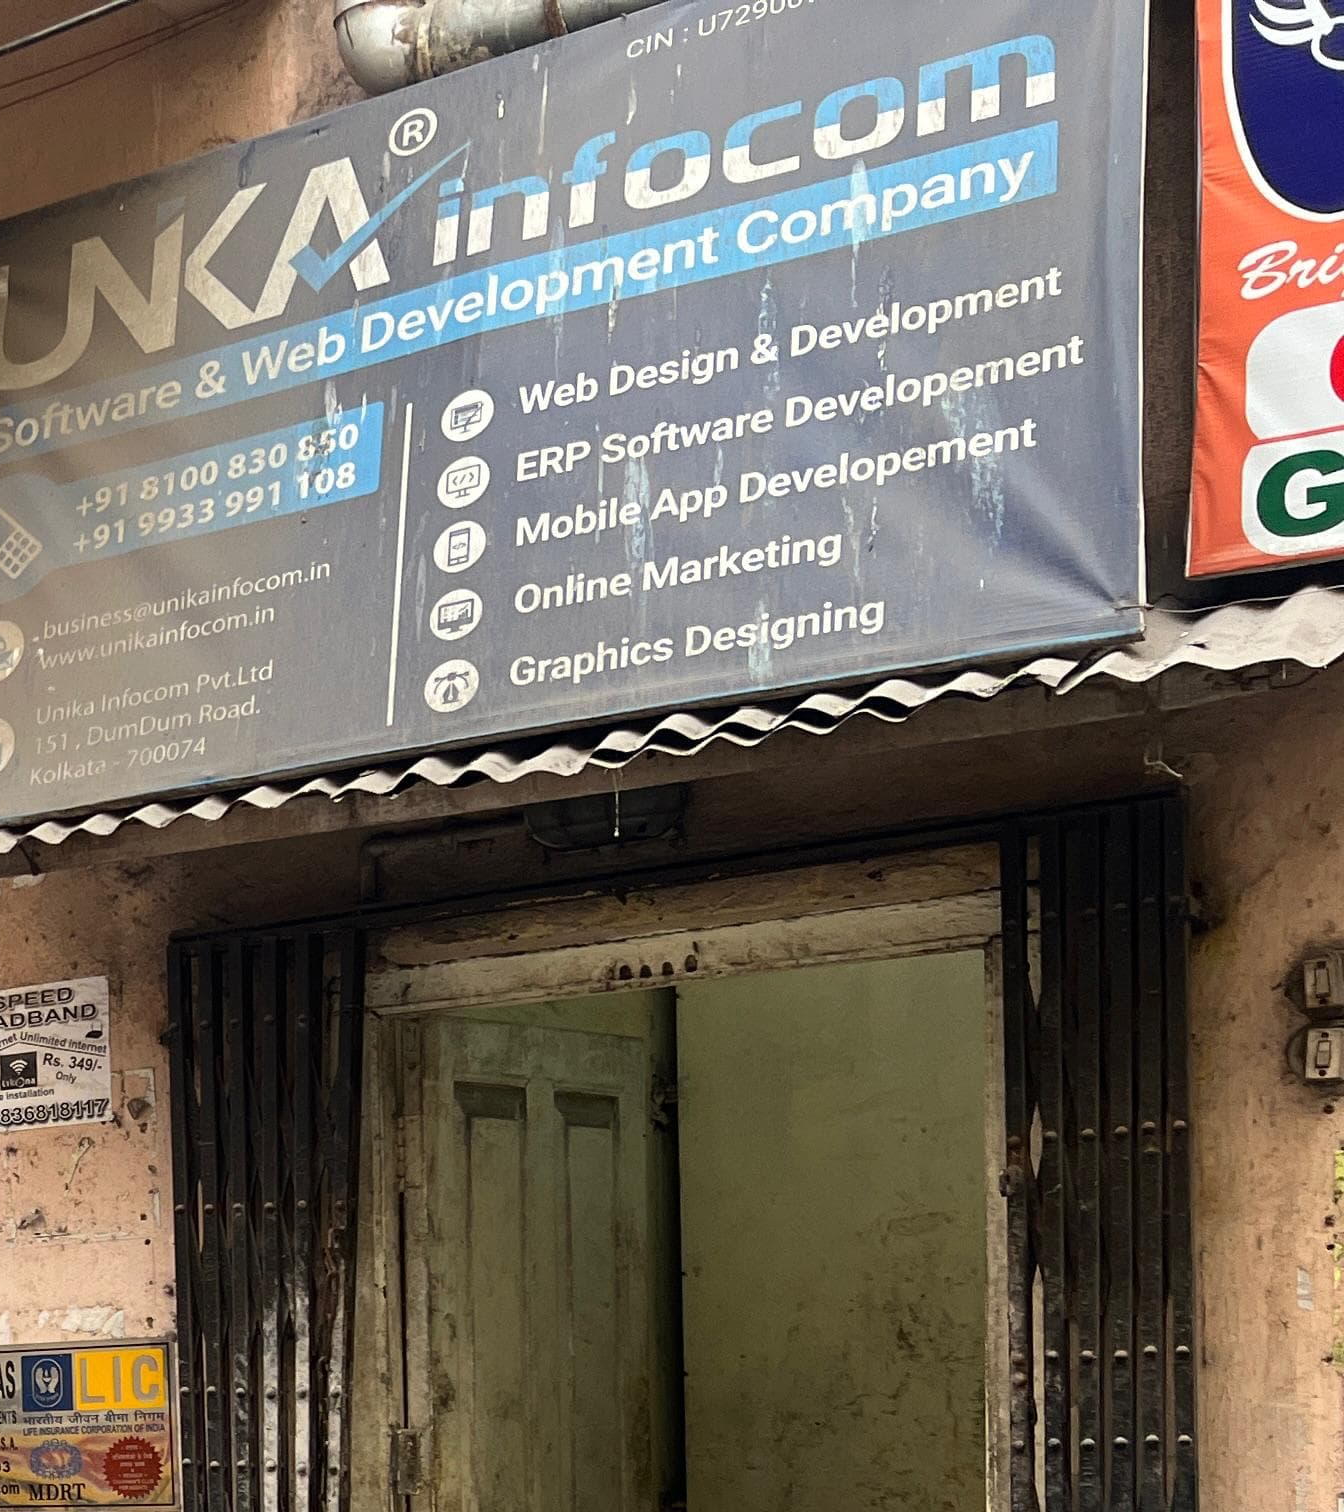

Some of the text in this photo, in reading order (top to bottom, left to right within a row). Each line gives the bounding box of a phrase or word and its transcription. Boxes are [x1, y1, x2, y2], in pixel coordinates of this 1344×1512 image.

[432, 34, 1056, 266] infocom
[196, 358, 227, 401] &
[242, 327, 345, 386] Web
[360, 225, 719, 353] Development
[736, 149, 1035, 254] Company
[1237, 240, 1344, 300] Bri
[519, 266, 1062, 414] Web Design & Development
[516, 334, 1085, 482] ERP Software Developement
[73, 463, 356, 555] +91 9933 991 108
[76, 484, 128, 518] +91
[141, 461, 218, 500] 8100
[227, 444, 288, 479] 830
[516, 419, 1037, 548] Mobile App Developement
[43, 562, 331, 640] business@unikainfocom.in
[514, 532, 842, 615] Online Marketing
[39, 606, 275, 670] www.unikainfocom.in
[510, 598, 886, 689] Graphics Designing
[34, 699, 261, 755] 151 DumDum Road.
[37, 660, 274, 724] Unika Infocom Pvt.Ltd
[30, 738, 206, 786] Kolkata 700074
[80, 1354, 160, 1402] LIC
[23, 1413, 62, 1425] भारतीय
[68, 1412, 99, 1424] जीवन
[134, 1410, 164, 1422] निगम
[28, 1483, 86, 1502] MDRT
